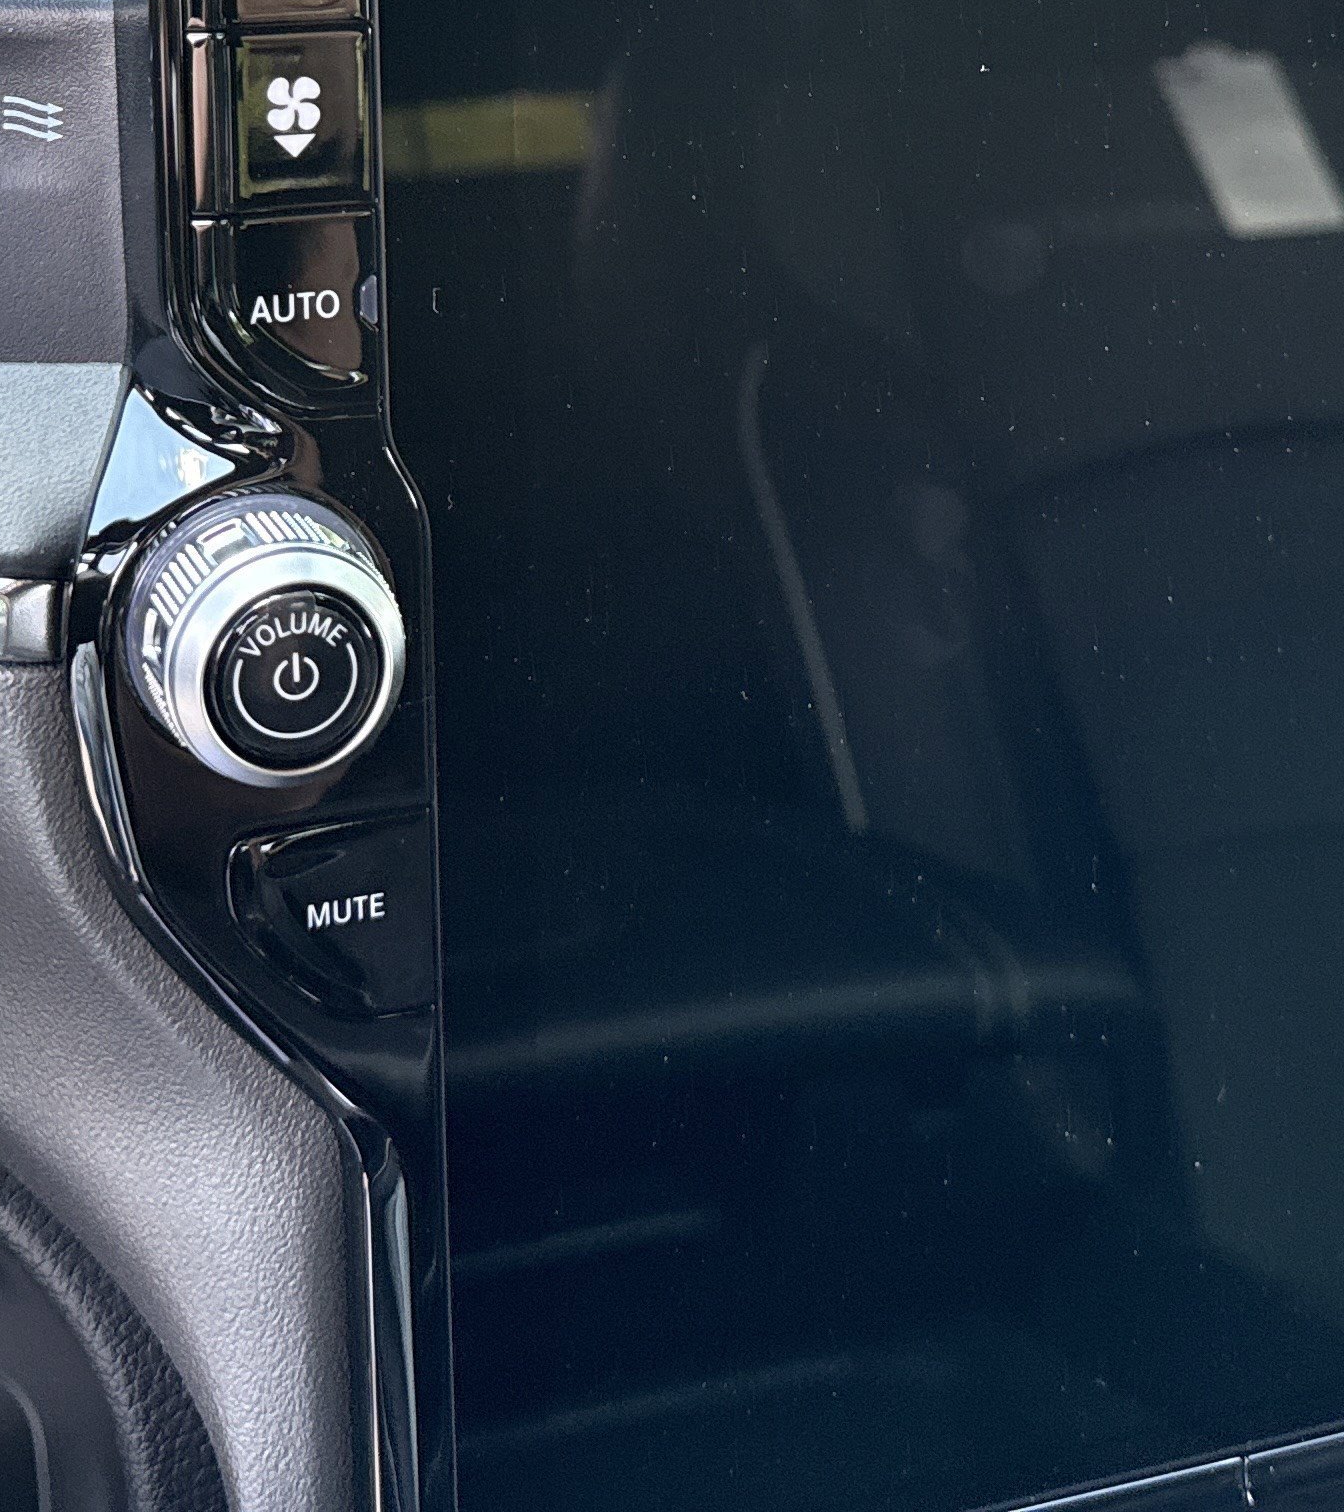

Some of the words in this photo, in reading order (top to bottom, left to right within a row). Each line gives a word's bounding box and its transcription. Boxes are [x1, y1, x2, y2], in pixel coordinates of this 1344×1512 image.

[249, 289, 341, 326] AUTO
[239, 611, 349, 659] VOLUME
[306, 891, 387, 930] MUTE
